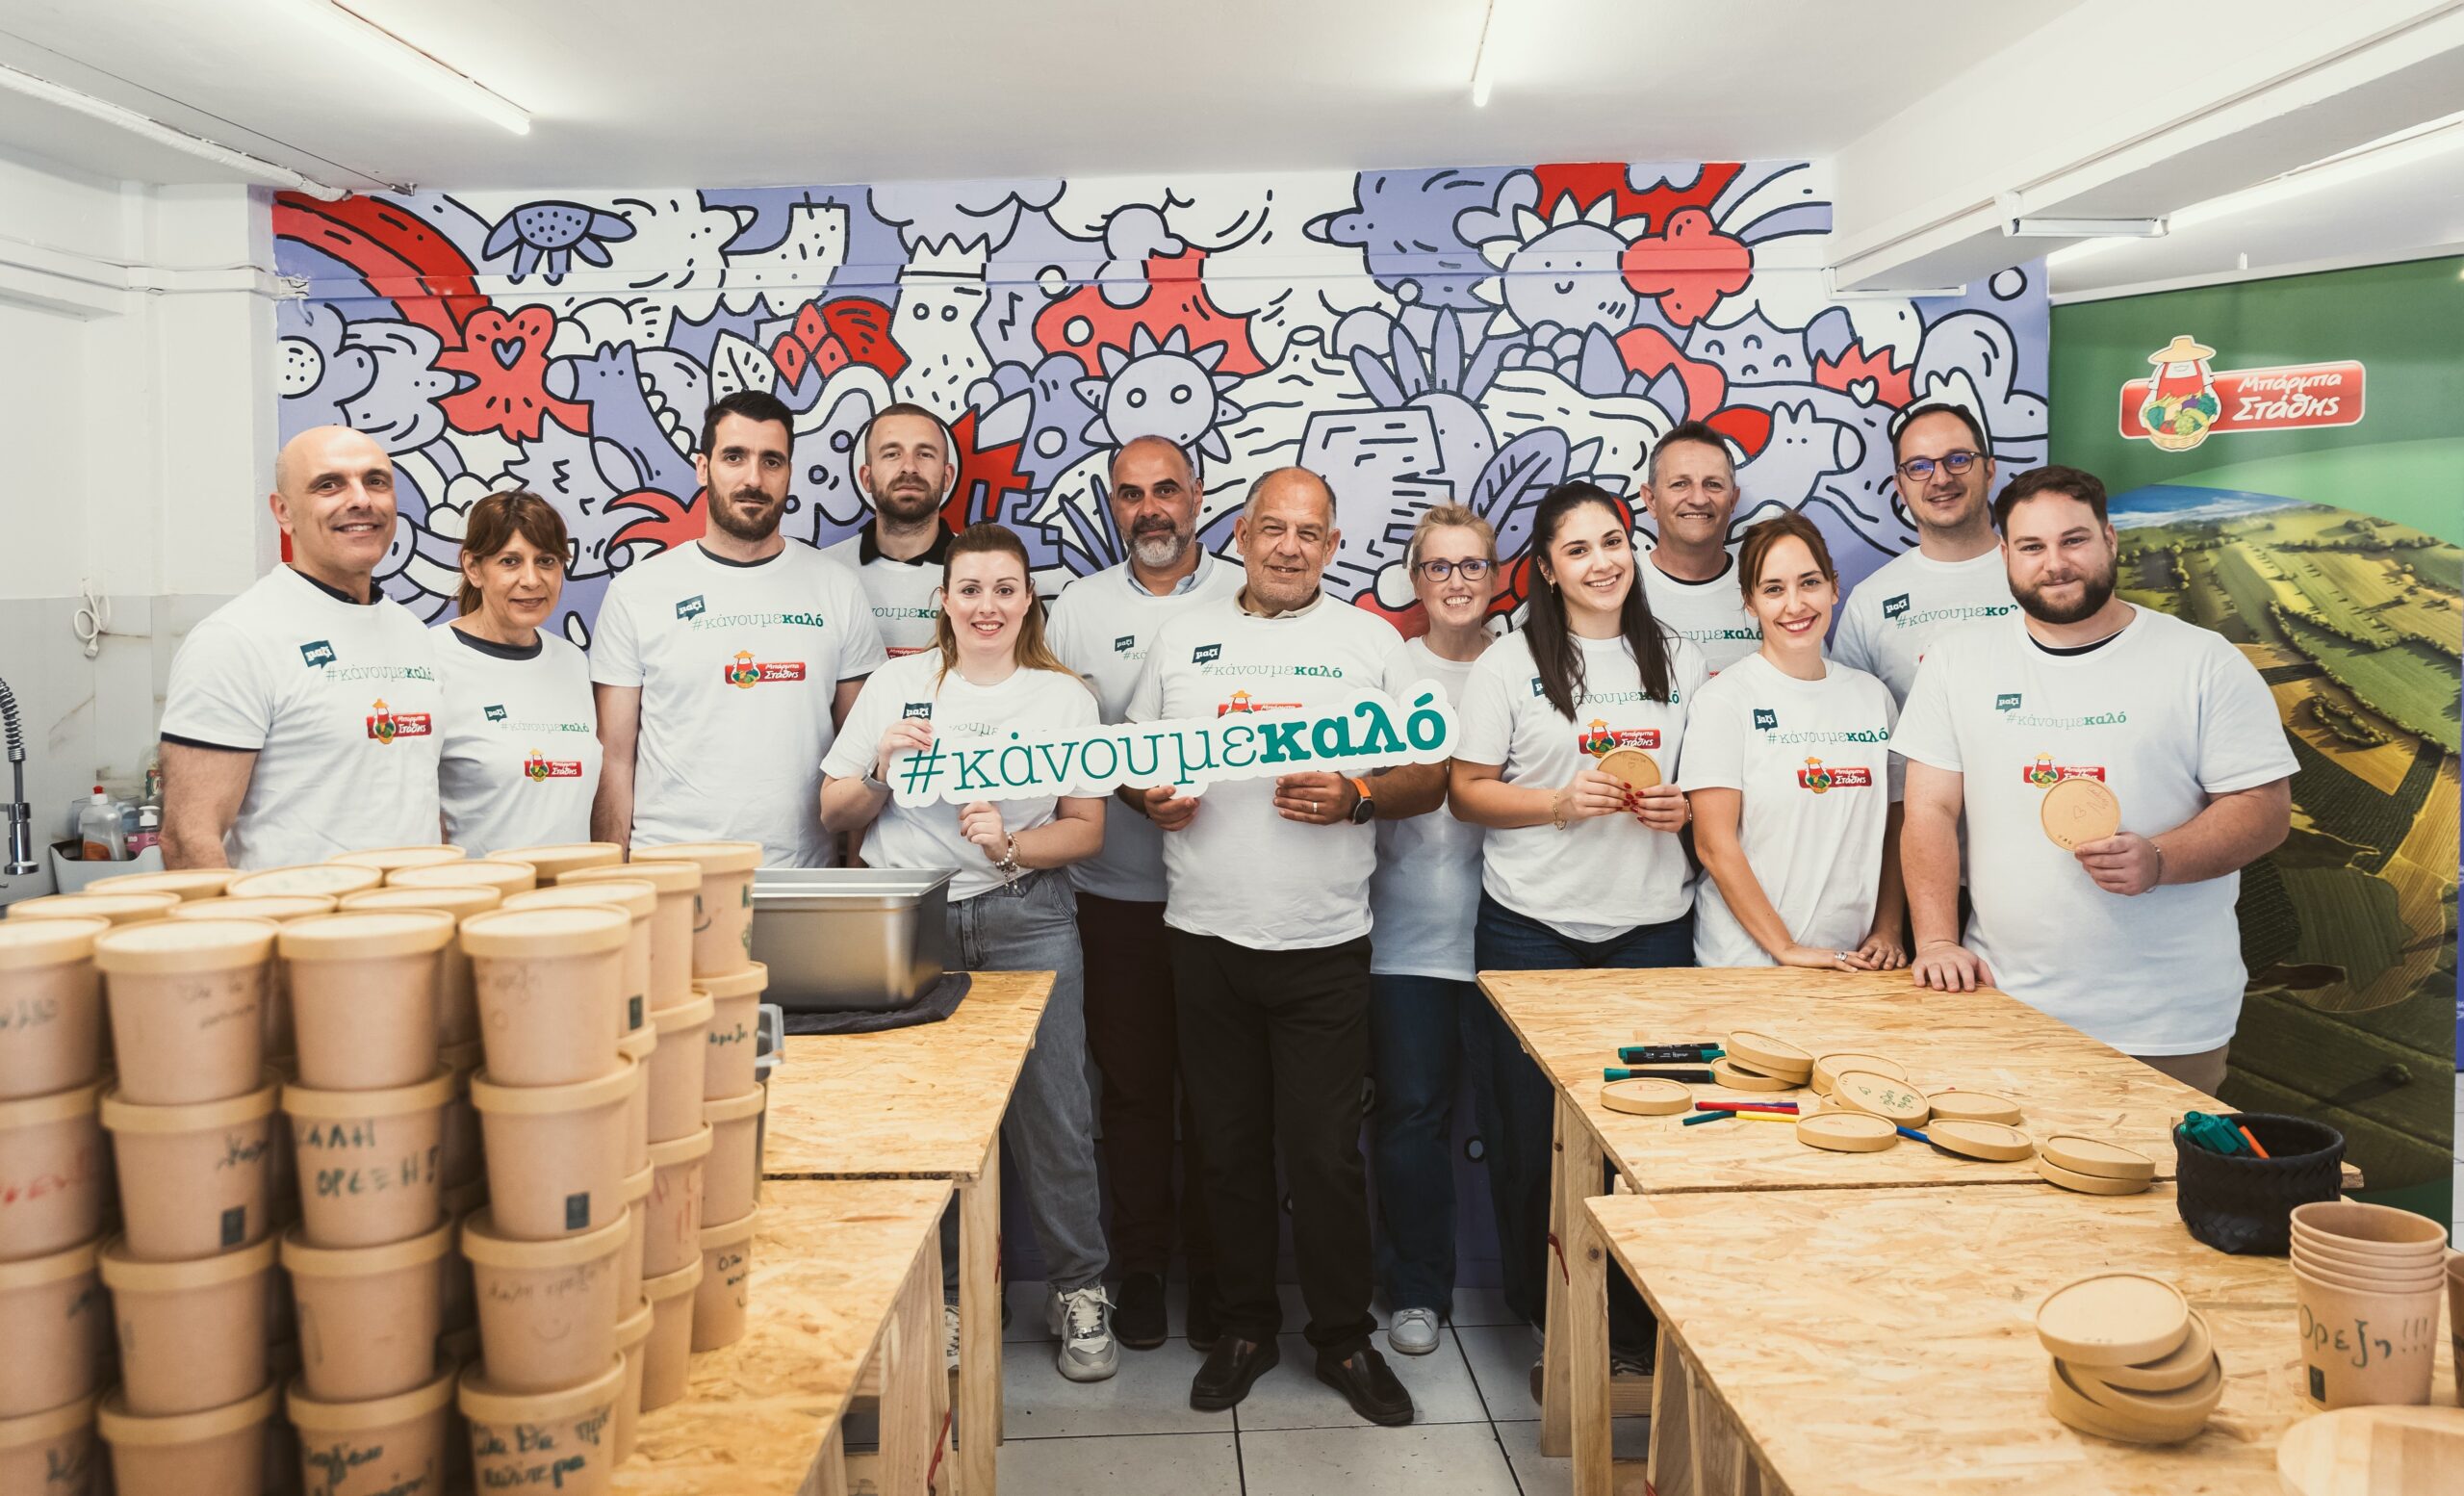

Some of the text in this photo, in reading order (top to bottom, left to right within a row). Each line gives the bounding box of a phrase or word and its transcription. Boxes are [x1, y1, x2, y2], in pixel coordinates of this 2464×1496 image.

[2238, 374, 2342, 394] Μπάρμπα
[2232, 393, 2340, 422] Στάθης
[679, 600, 703, 615] μαζί
[1886, 598, 1909, 613] μαζί
[692, 612, 824, 632] #κάνουμεκαλό
[1896, 604, 2018, 630] #κάνουμεκα
[1195, 649, 1219, 660] μαζί
[1201, 662, 1344, 680] #κάνουμεκαλό
[1997, 697, 2019, 707] μαζί
[906, 708, 930, 717] μαζί
[2006, 711, 2127, 731] #κάνουμεκαλό
[900, 691, 1447, 795] #κάνουμεκαλό
[1767, 727, 1889, 745] #κάνουμεκαλό
